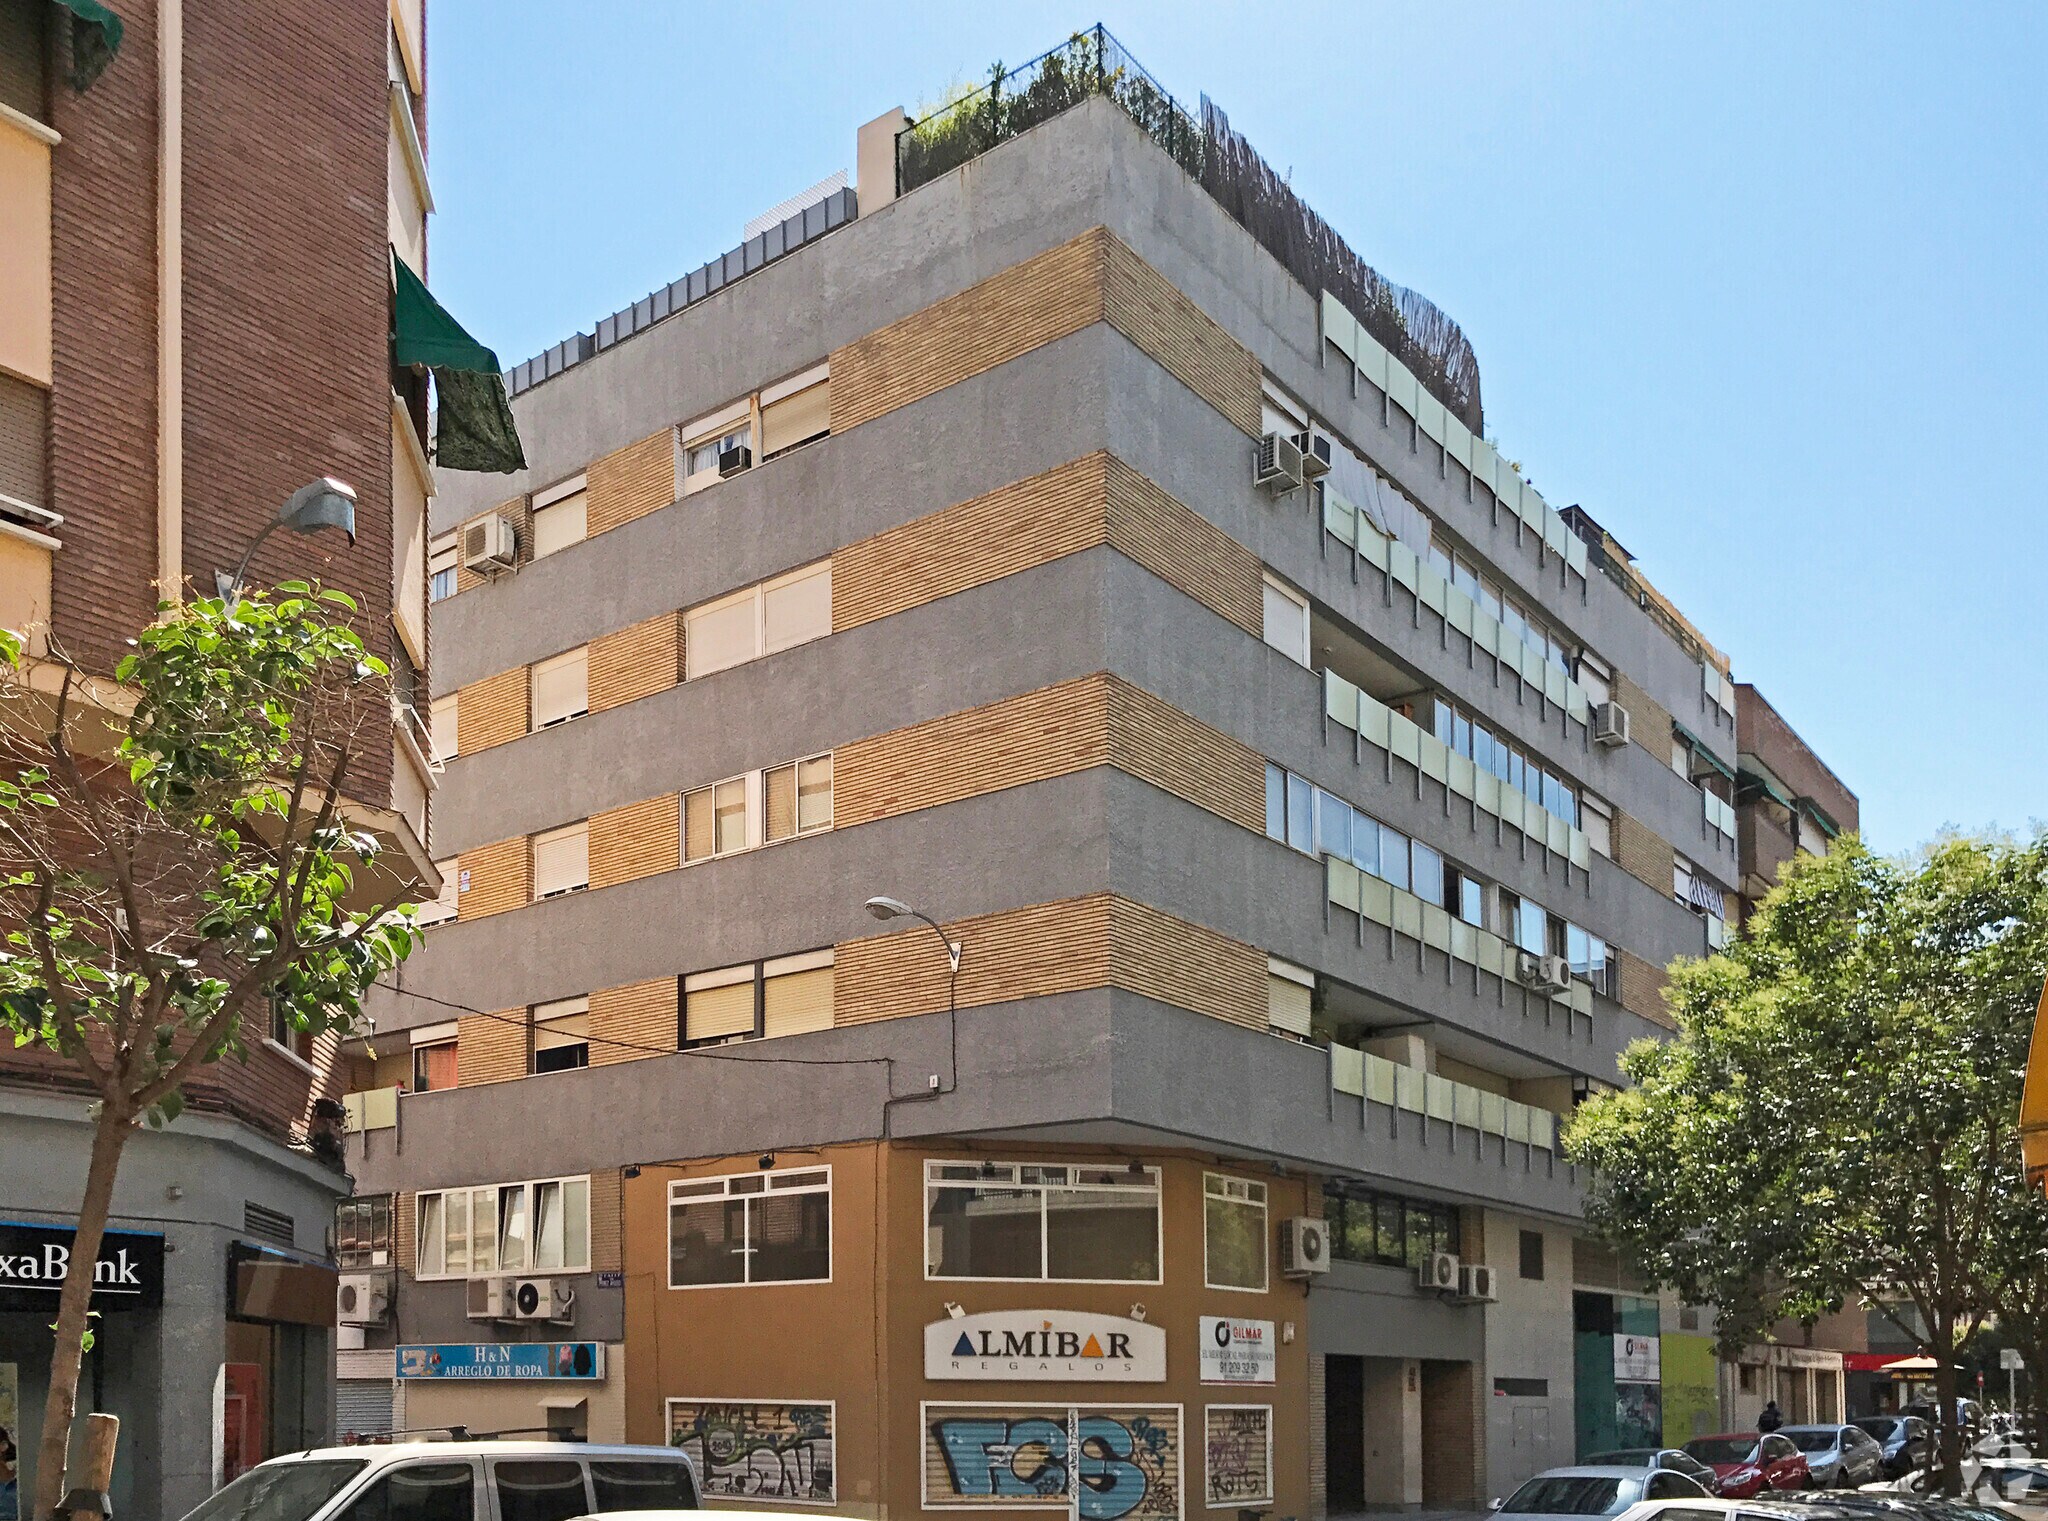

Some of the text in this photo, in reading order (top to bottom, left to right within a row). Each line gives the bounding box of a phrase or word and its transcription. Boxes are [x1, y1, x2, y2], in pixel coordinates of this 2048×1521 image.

[0, 1243, 141, 1285] xaBnk
[1233, 1326, 1263, 1340] GILMAR
[474, 1345, 511, 1363] H & N
[444, 1364, 543, 1377] ARREGLO DE ROPA
[951, 1361, 1132, 1372] REGALOS
